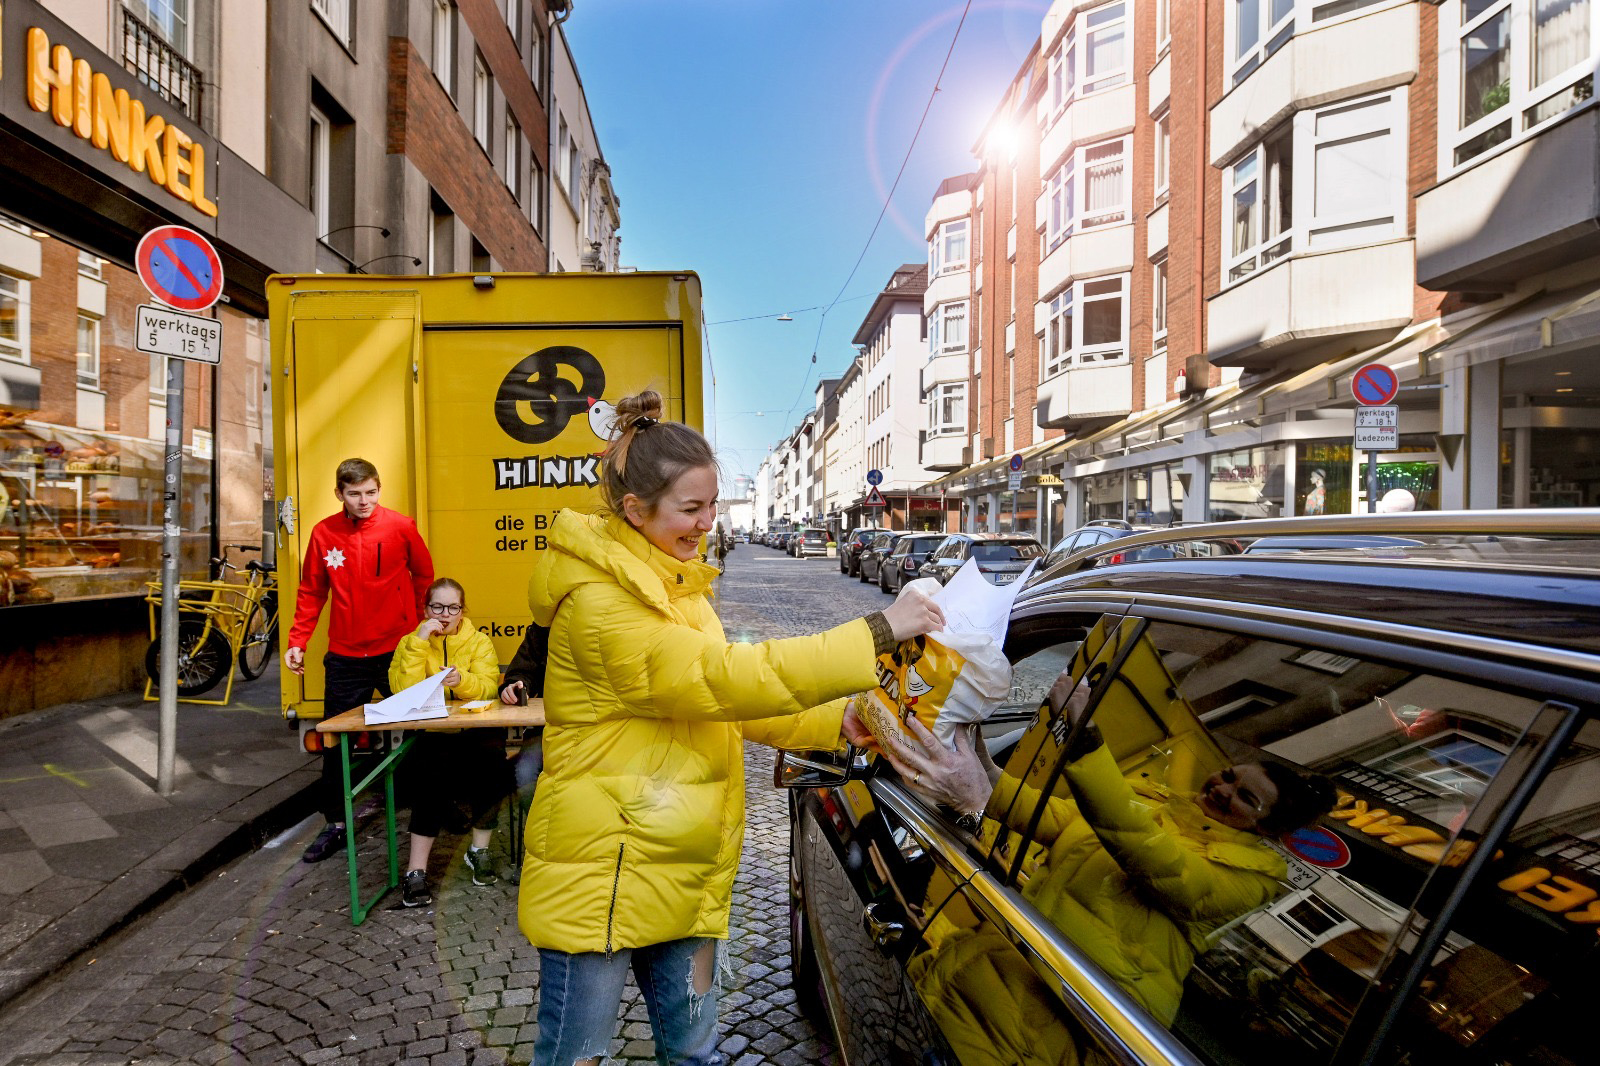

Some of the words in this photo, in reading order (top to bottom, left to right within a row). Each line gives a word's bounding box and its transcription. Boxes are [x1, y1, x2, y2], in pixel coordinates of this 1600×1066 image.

[27, 26, 218, 218] HINKEL
[145, 316, 217, 342] werktags
[149, 333, 157, 346] 5
[181, 339, 196, 353] 15
[1359, 410, 1394, 419] werktags
[1357, 434, 1395, 442] Ladezone
[495, 515, 525, 530] die
[496, 536, 528, 550] der
